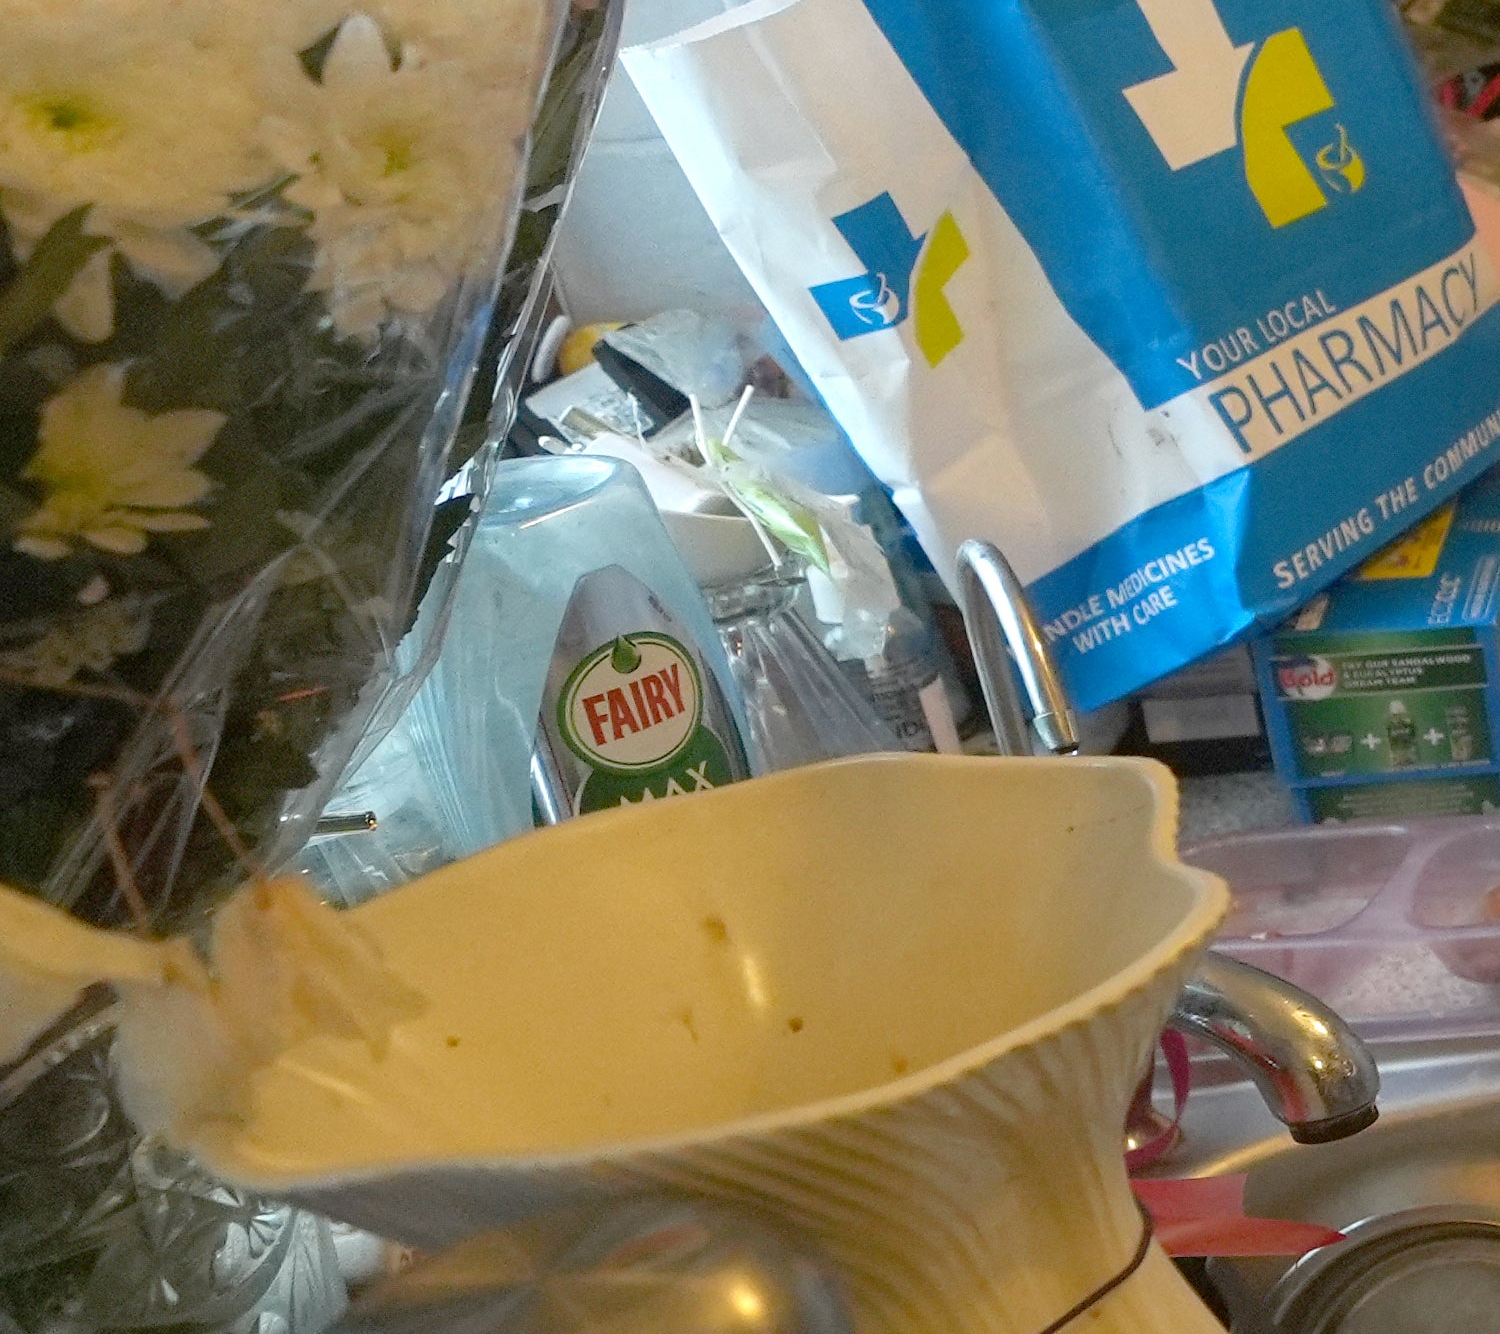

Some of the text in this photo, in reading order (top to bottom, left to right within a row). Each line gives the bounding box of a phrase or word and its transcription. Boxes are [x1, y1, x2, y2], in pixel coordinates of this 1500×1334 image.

[1176, 288, 1338, 381] YOUR LOCAL
[1207, 251, 1480, 454] PHARMACY
[1272, 506, 1376, 590] SERVING
[1374, 476, 1420, 520] THE
[1042, 536, 1216, 644] NDLE MEDICINES
[1072, 584, 1179, 655] WITH CARE
[581, 662, 687, 748] FAIRY
